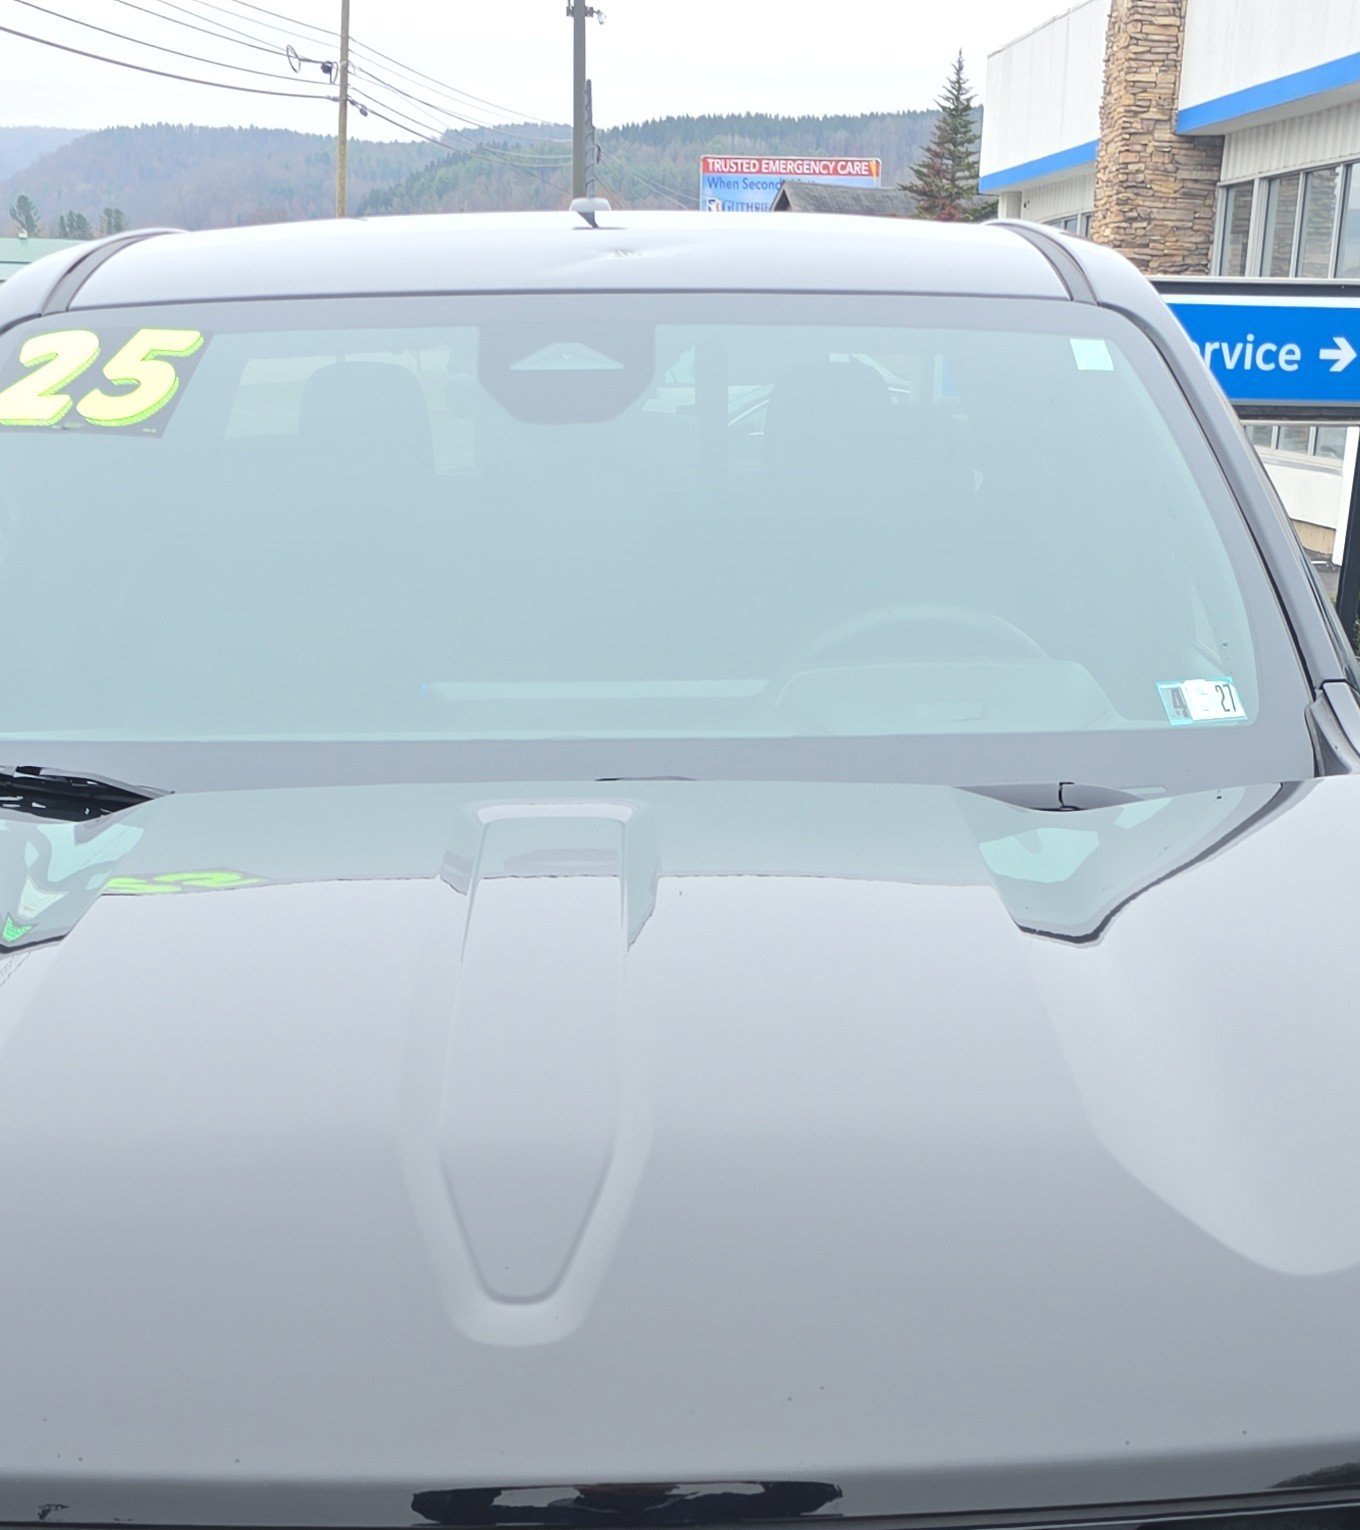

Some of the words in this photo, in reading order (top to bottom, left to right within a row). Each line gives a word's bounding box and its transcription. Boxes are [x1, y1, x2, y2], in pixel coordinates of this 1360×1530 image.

[707, 158, 759, 173] TRUSTED
[761, 159, 835, 174] EMERGENCY
[837, 161, 869, 175] CARE
[707, 176, 739, 190] When
[1191, 333, 1302, 372] rvice
[1215, 683, 1237, 713] 27
